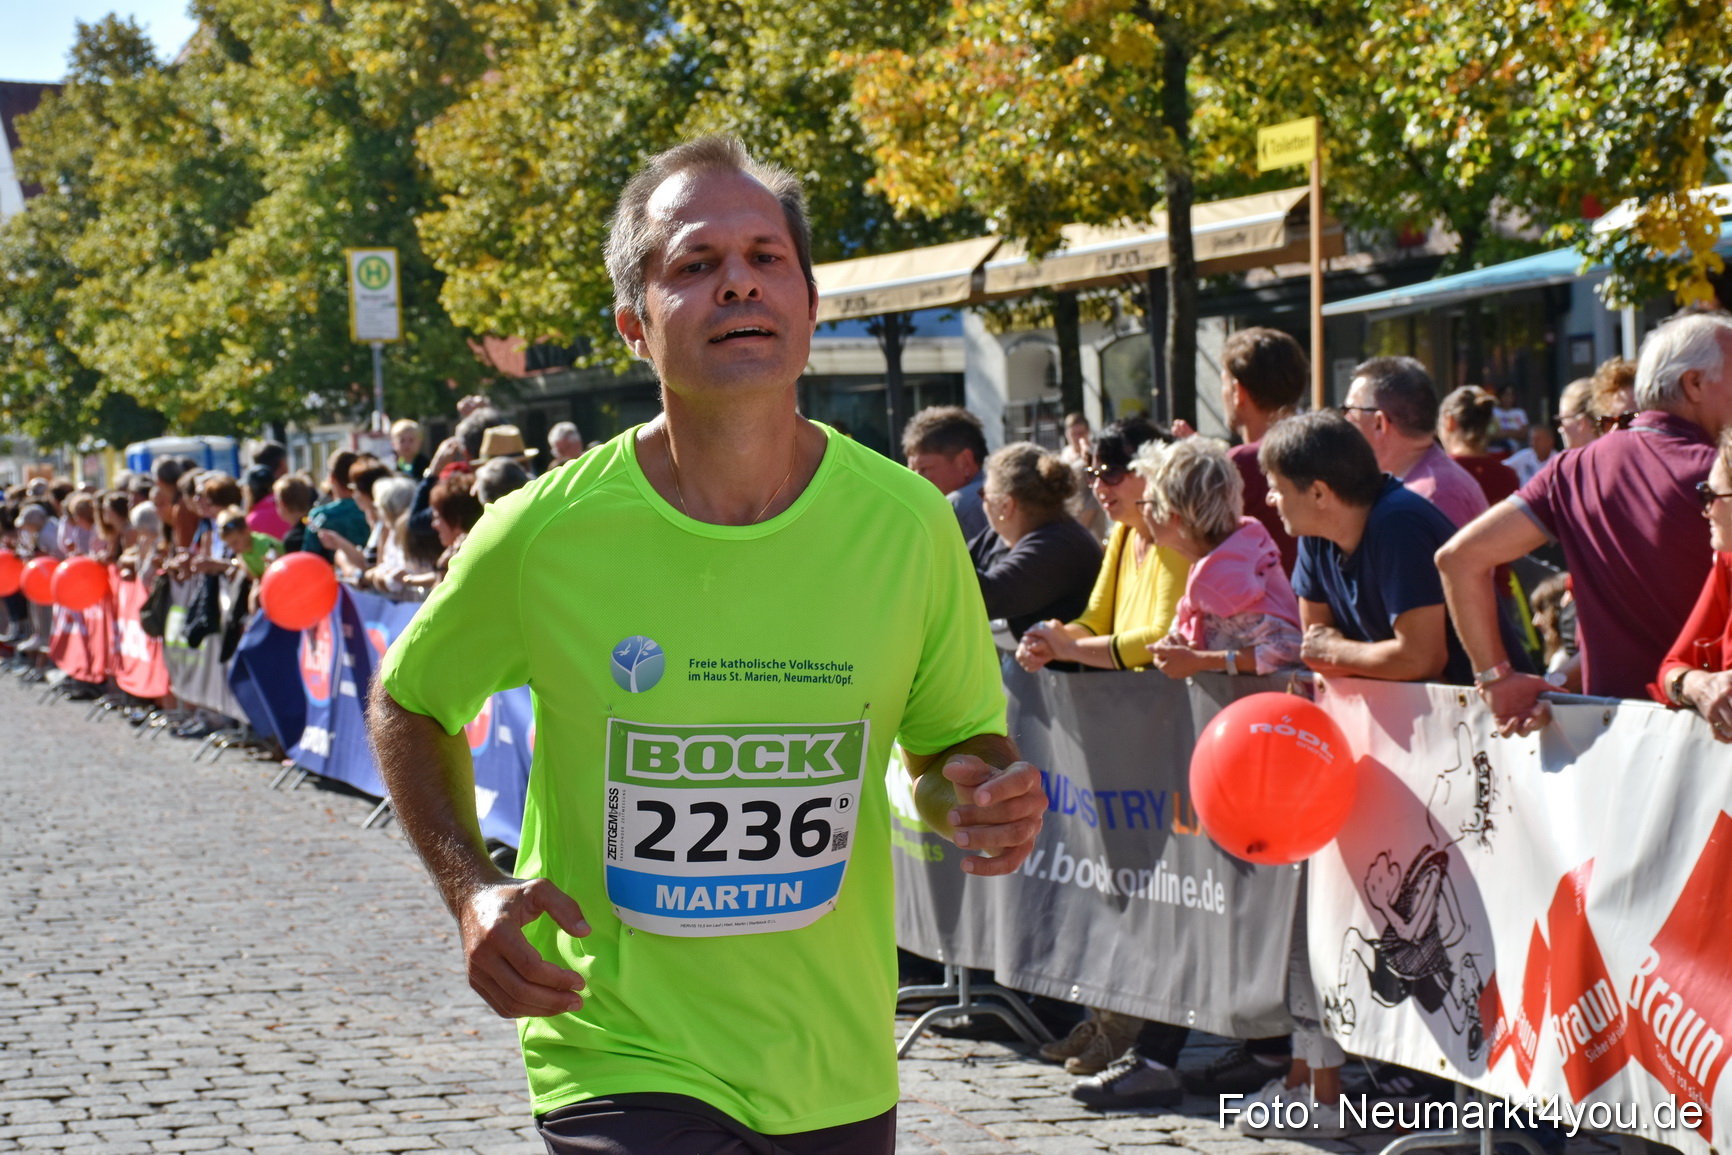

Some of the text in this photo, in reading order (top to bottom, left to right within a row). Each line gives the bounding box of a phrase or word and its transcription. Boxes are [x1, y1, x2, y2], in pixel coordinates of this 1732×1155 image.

[688, 671, 854, 687] im Haus St. Marien, Neumarkt/Opf.
[689, 658, 854, 672] Freie katholische Volksschule
[628, 733, 844, 779] BOCK
[839, 797, 849, 809] D
[634, 797, 832, 862] 2236
[655, 881, 804, 911] MARTIN
[1551, 977, 1620, 1068] Braun
[1626, 944, 1724, 1088] Braun
